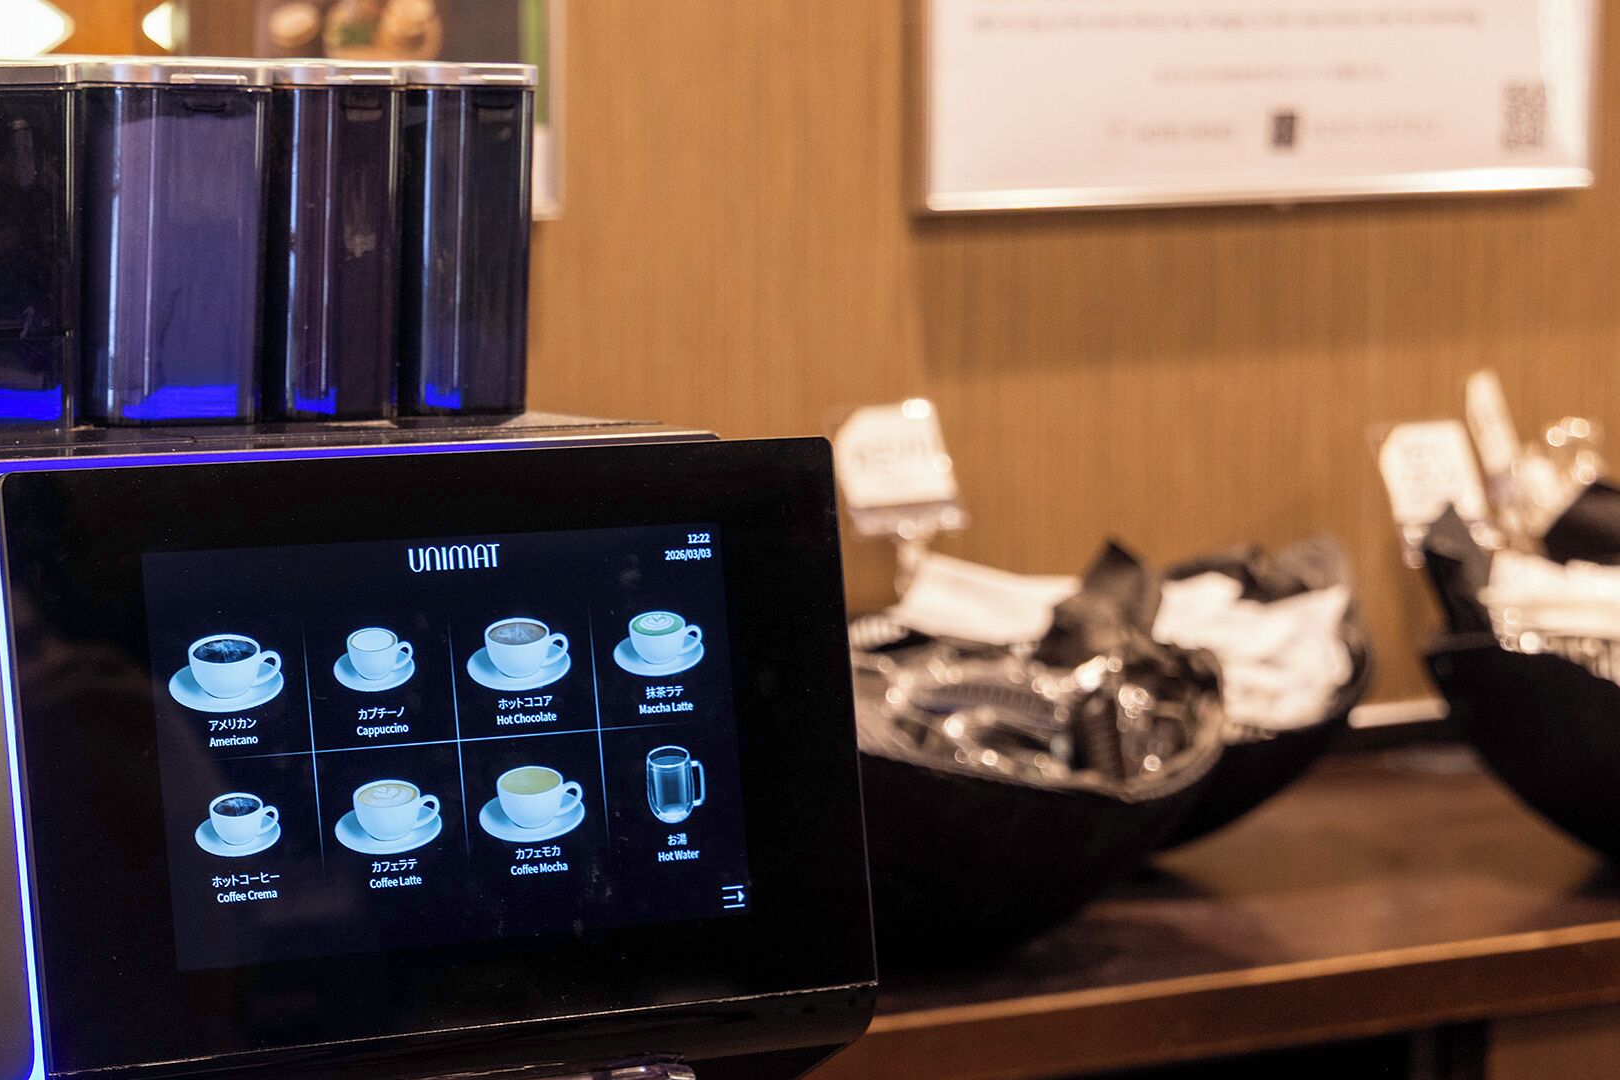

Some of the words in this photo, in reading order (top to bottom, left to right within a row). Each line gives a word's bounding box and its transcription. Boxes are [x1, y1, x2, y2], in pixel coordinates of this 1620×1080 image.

[687, 533, 711, 544] 12:22
[408, 544, 500, 573] UNIMAT
[664, 548, 712, 561] 2026/03/03
[645, 685, 684, 699] 抹茶ラテ
[497, 695, 553, 710] ホットココア
[638, 702, 671, 714] Maccha
[671, 701, 694, 712] Latte
[358, 706, 404, 720] カプチーノ
[496, 714, 514, 725] Hot
[514, 711, 557, 724] Chocolate
[208, 717, 257, 731] アメリカン
[356, 722, 409, 738] Cappuccino
[209, 734, 258, 748] Americano
[667, 832, 688, 846] お湯
[515, 844, 561, 860] カフェモカ
[657, 851, 675, 862] Hot
[673, 849, 700, 861] Water
[371, 858, 418, 873] カフェラテ
[510, 863, 539, 876] Coffee
[539, 860, 569, 874] Mocha
[211, 871, 280, 888] ホットコーヒー
[369, 876, 399, 889] Coffee
[399, 875, 422, 887] Latte
[216, 890, 247, 904] Coffee
[247, 889, 278, 901] Crema
